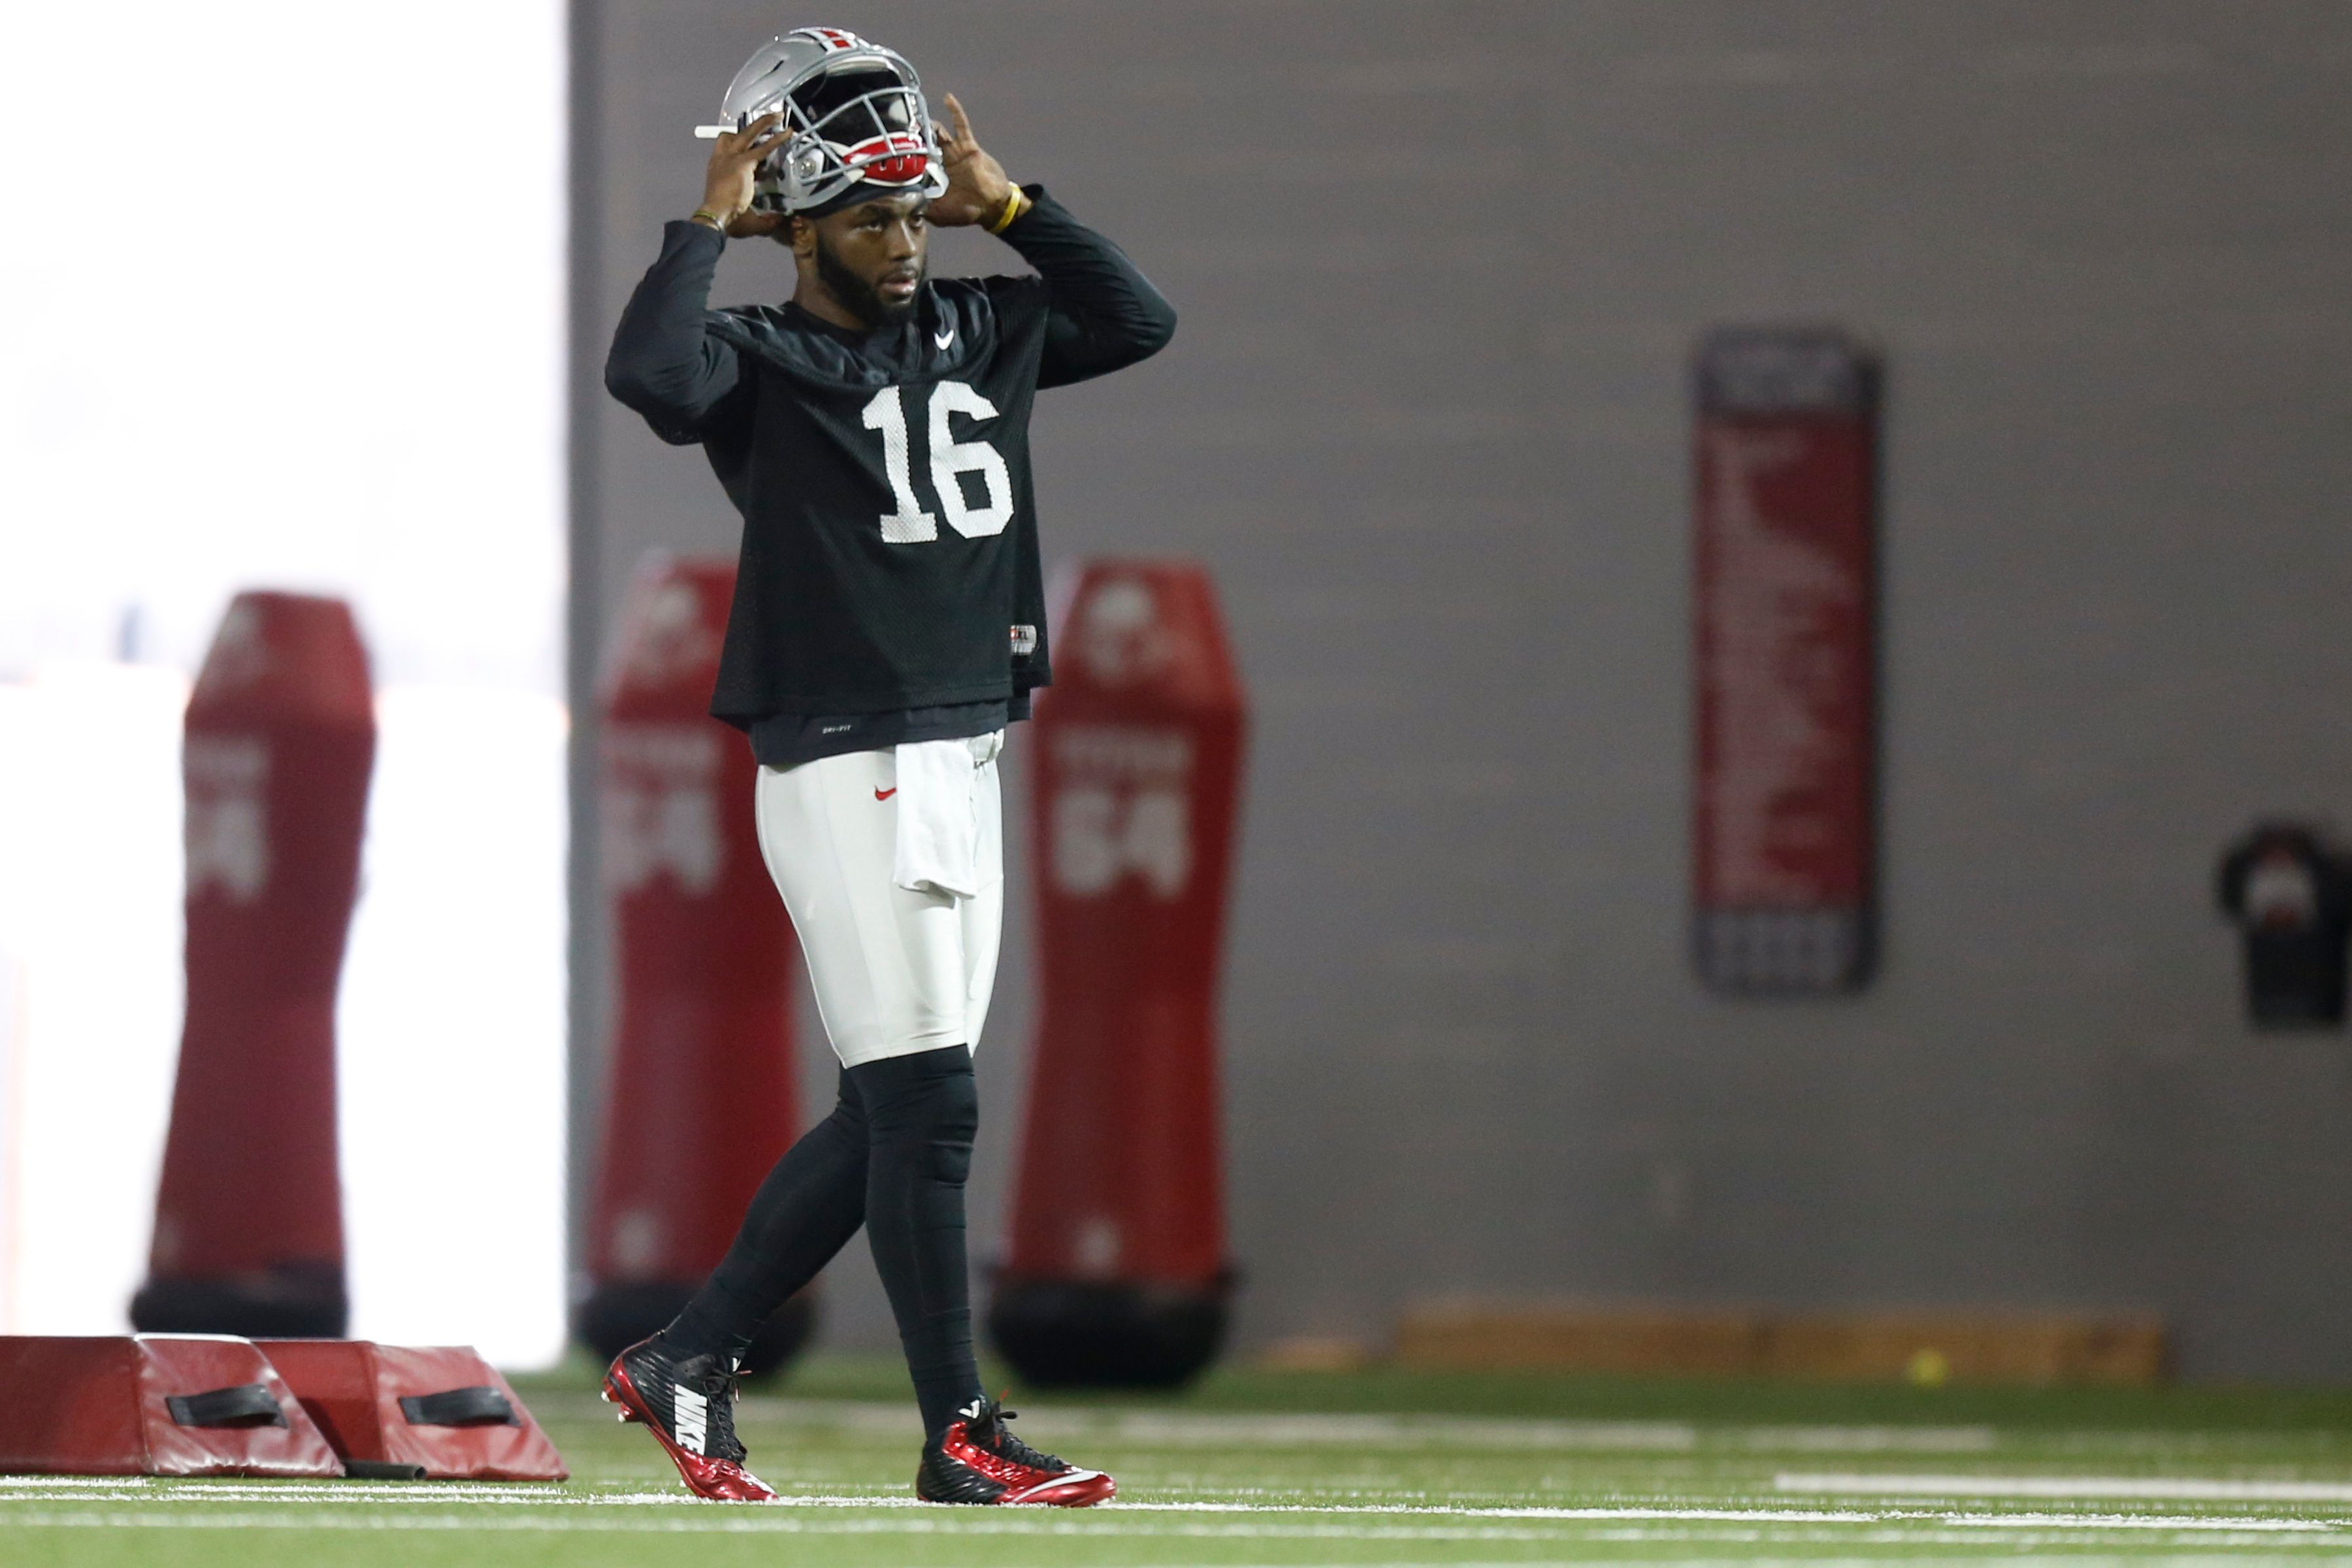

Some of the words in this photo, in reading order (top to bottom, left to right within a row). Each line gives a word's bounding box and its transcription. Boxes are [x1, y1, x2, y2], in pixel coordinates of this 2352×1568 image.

[862, 380, 1015, 544] 16
[822, 724, 851, 734] DRI-FIT
[674, 1383, 708, 1456] NIKE
